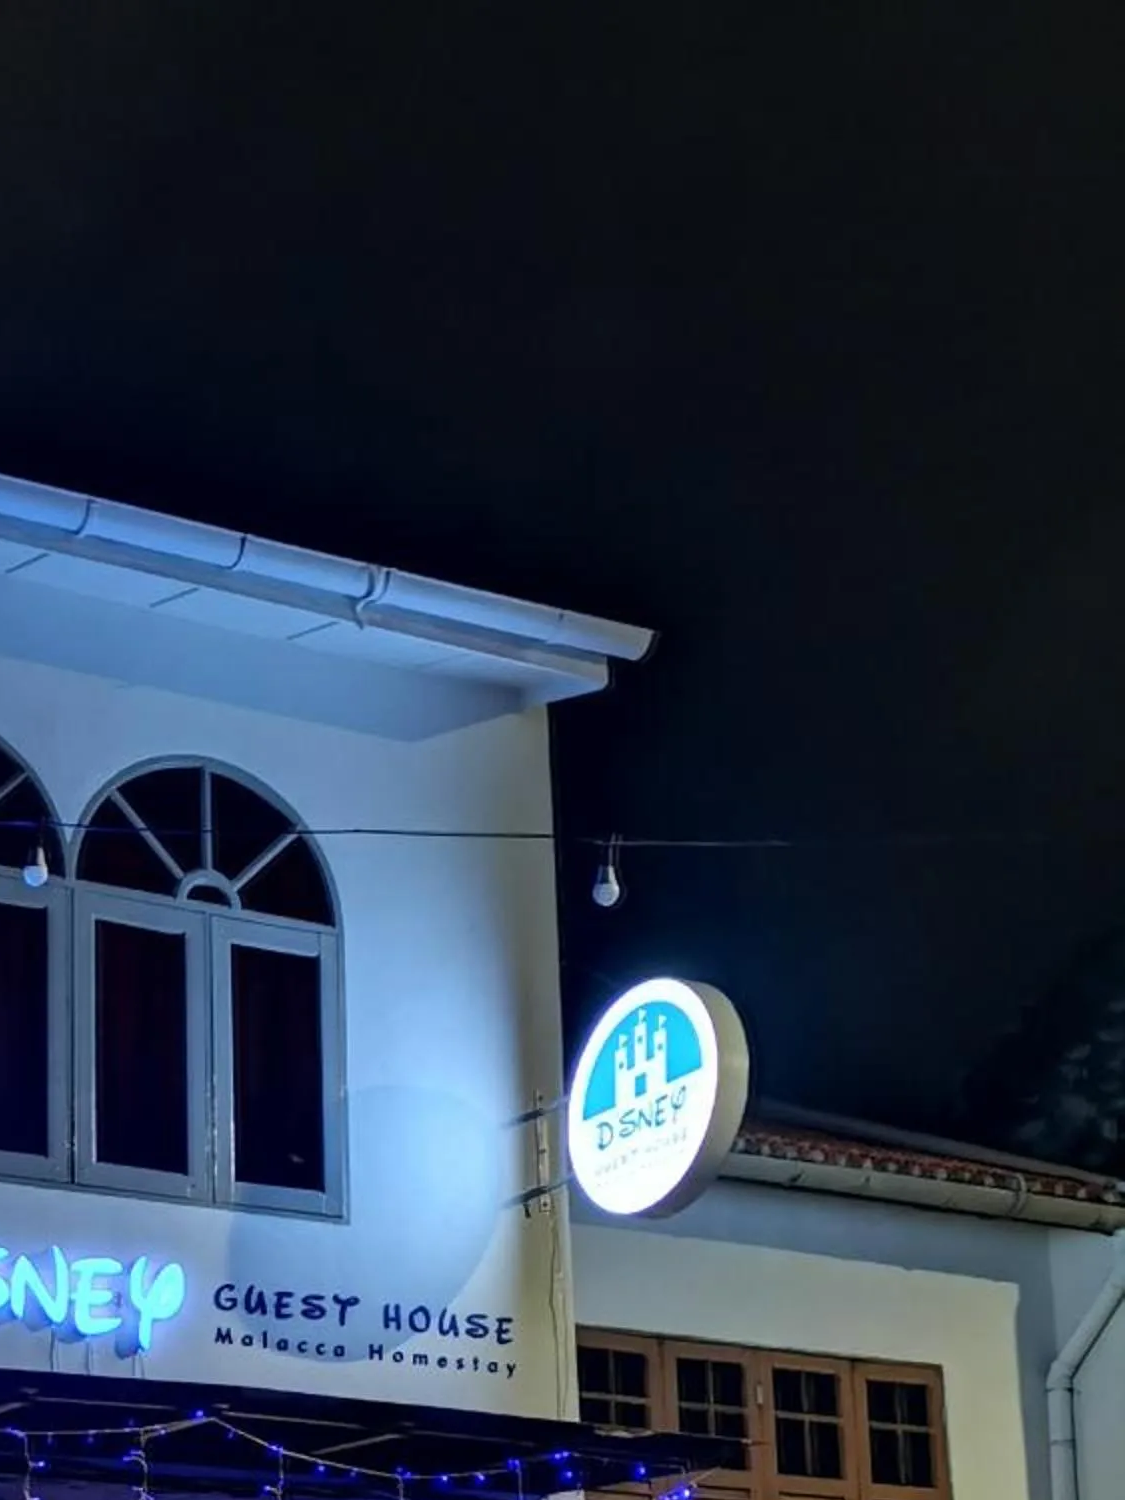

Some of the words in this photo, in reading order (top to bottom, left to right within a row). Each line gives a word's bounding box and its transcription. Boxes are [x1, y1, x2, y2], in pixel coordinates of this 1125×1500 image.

[213, 1283, 361, 1326] GUEST
[382, 1303, 515, 1345] HOUSE
[214, 1327, 346, 1357] Malacca
[368, 1344, 517, 1378] Homestay
